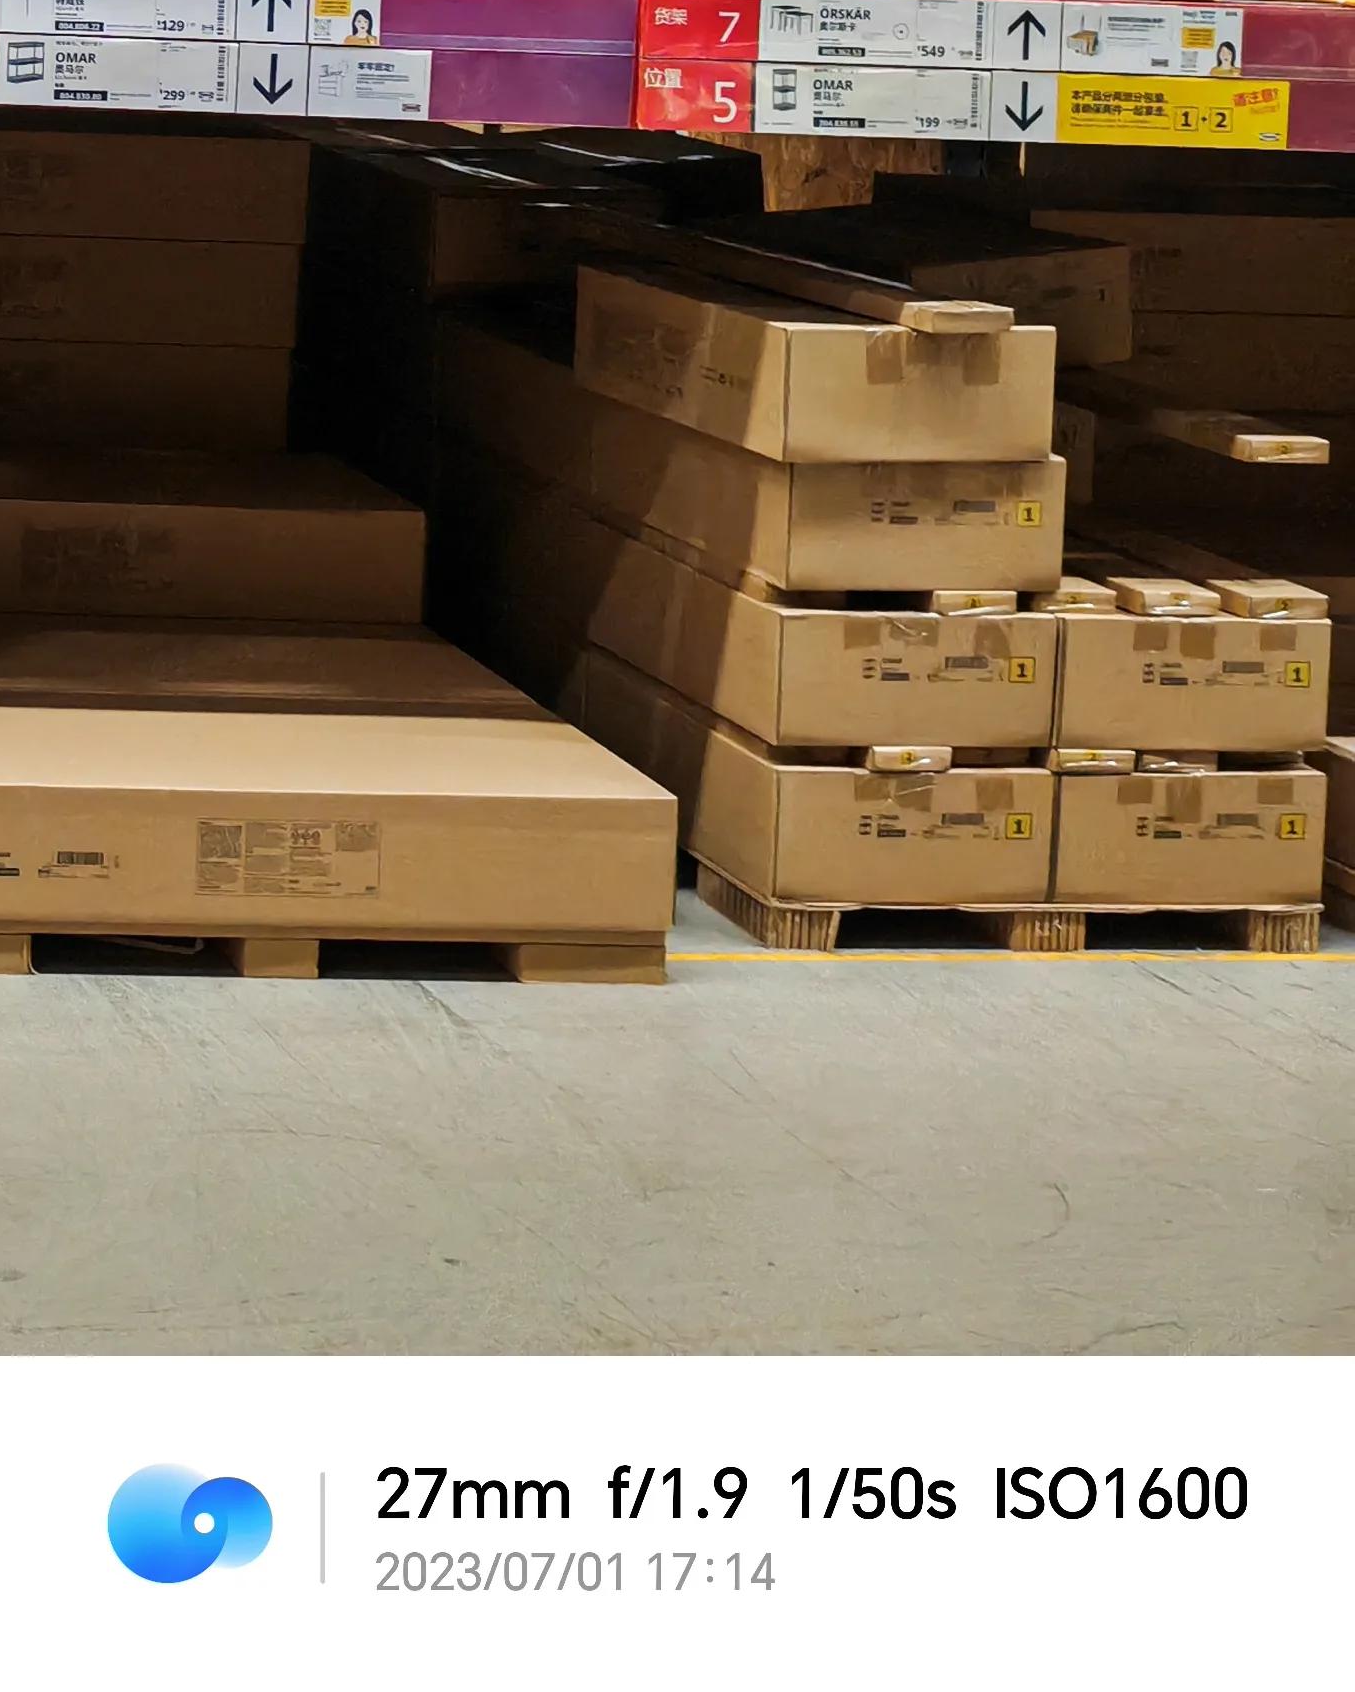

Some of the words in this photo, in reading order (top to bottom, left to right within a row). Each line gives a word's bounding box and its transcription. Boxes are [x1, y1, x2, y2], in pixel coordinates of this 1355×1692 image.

[718, 11, 740, 43] 7
[55, 51, 97, 64] OMAR
[812, 79, 854, 91] OMAR
[712, 81, 738, 123] 5
[1180, 111, 1192, 127] 1
[1215, 111, 1228, 128] 2
